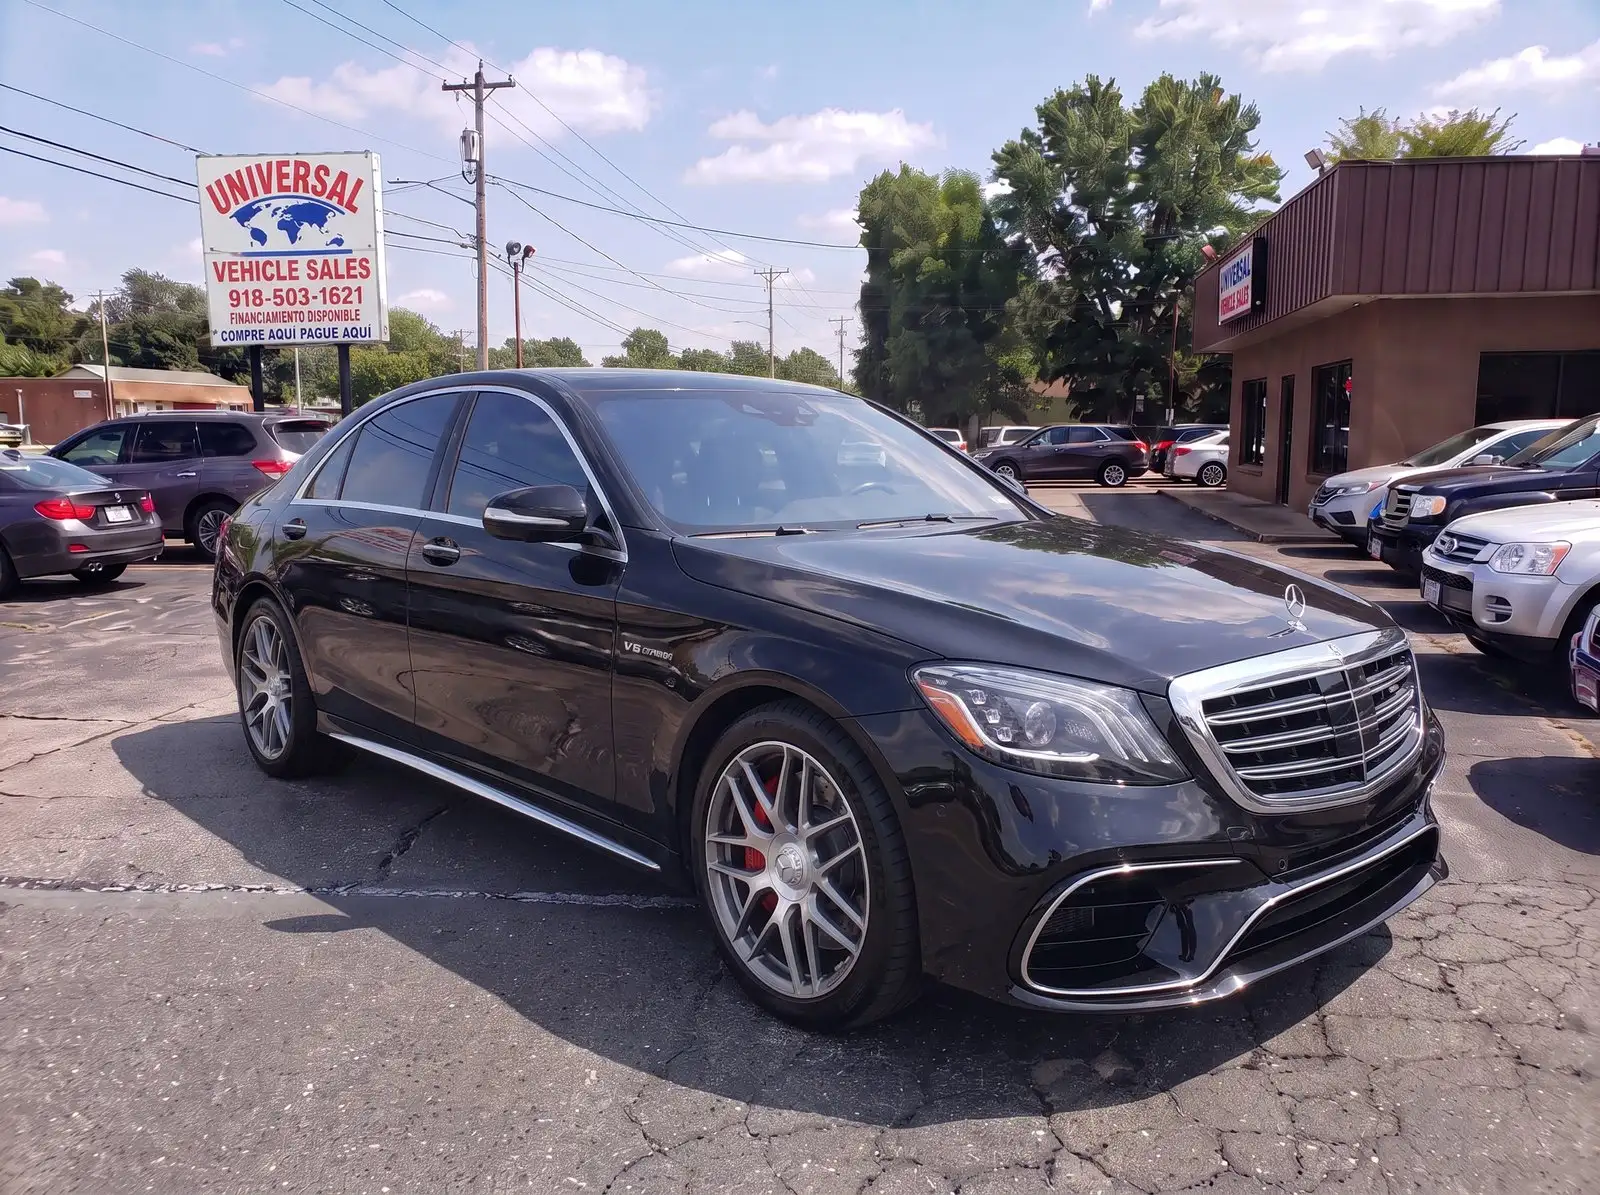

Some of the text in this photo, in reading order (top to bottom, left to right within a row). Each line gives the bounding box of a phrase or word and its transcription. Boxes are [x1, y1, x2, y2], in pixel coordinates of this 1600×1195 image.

[206, 160, 364, 214] UNIVERSAL
[212, 257, 371, 282] VEHICLE SALES
[228, 286, 364, 308] 918-503-1621
[230, 309, 360, 324] FINANCIAMIENTO DISPONIBLE
[221, 329, 264, 342] COMPRE
[300, 327, 338, 340] PAGUE
